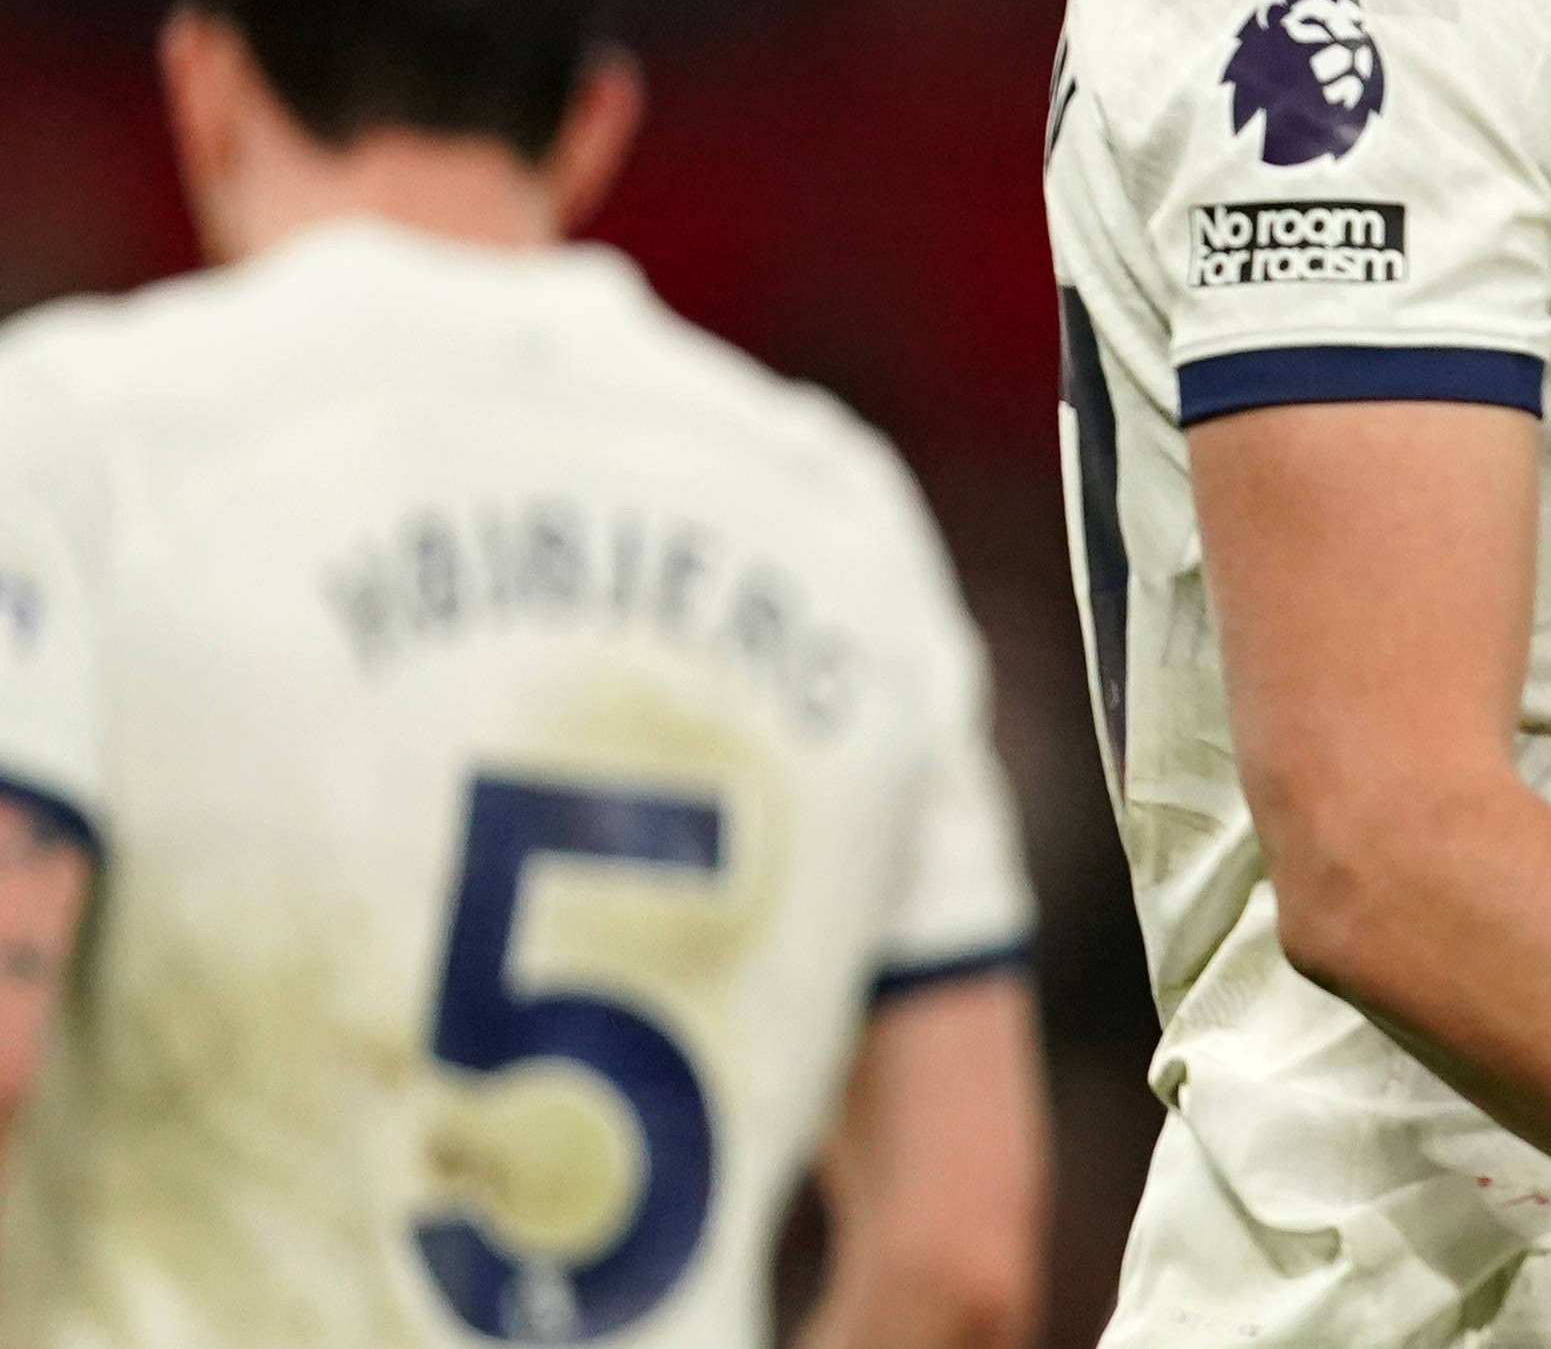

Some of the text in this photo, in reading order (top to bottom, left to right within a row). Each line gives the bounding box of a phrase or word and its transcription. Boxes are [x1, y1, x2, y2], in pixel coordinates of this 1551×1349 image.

[1191, 204, 1386, 250] No room
[1190, 244, 1405, 286] for racism
[411, 767, 725, 1345] 5
